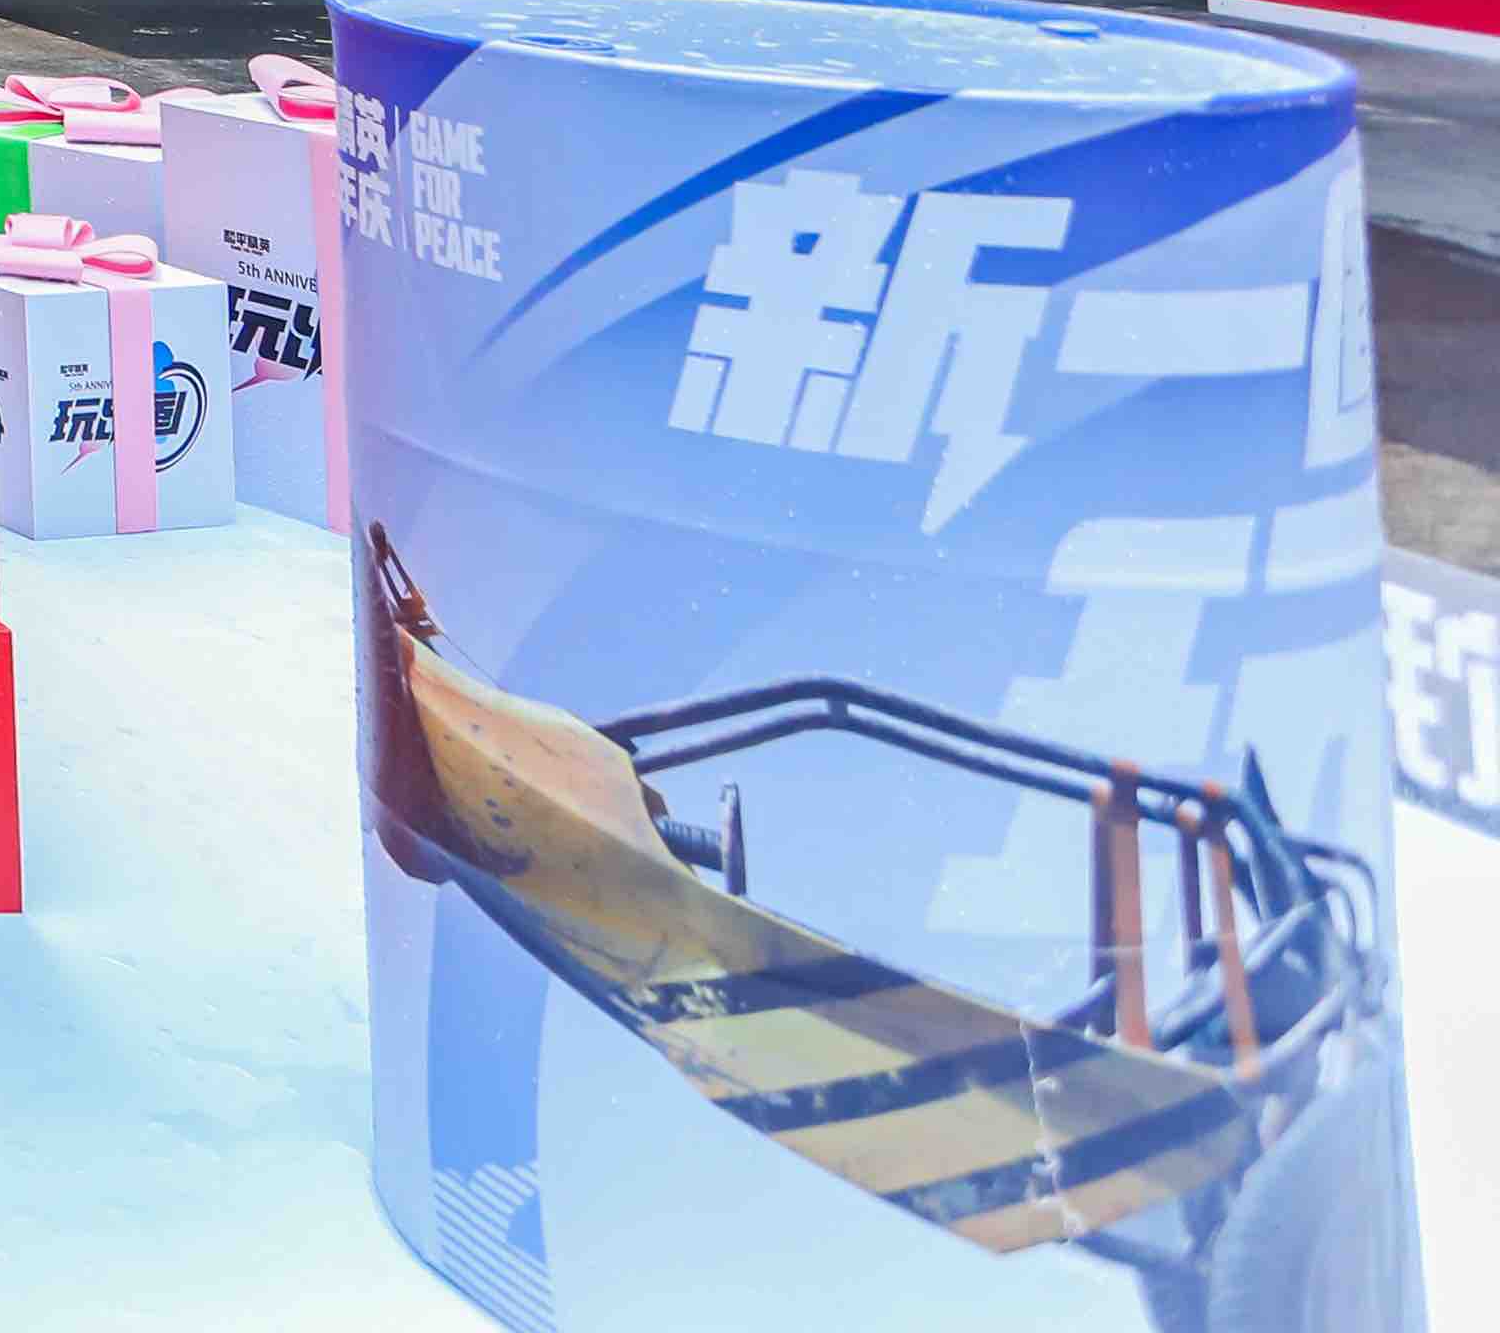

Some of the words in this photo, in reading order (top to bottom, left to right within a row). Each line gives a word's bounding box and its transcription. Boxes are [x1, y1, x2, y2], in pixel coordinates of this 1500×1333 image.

[409, 109, 486, 176] GAME
[412, 161, 463, 220] FOR
[414, 210, 503, 283] PEACE
[238, 260, 260, 279] 5th
[264, 267, 317, 293] ANNIVE
[84, 380, 113, 391] ANNIV
